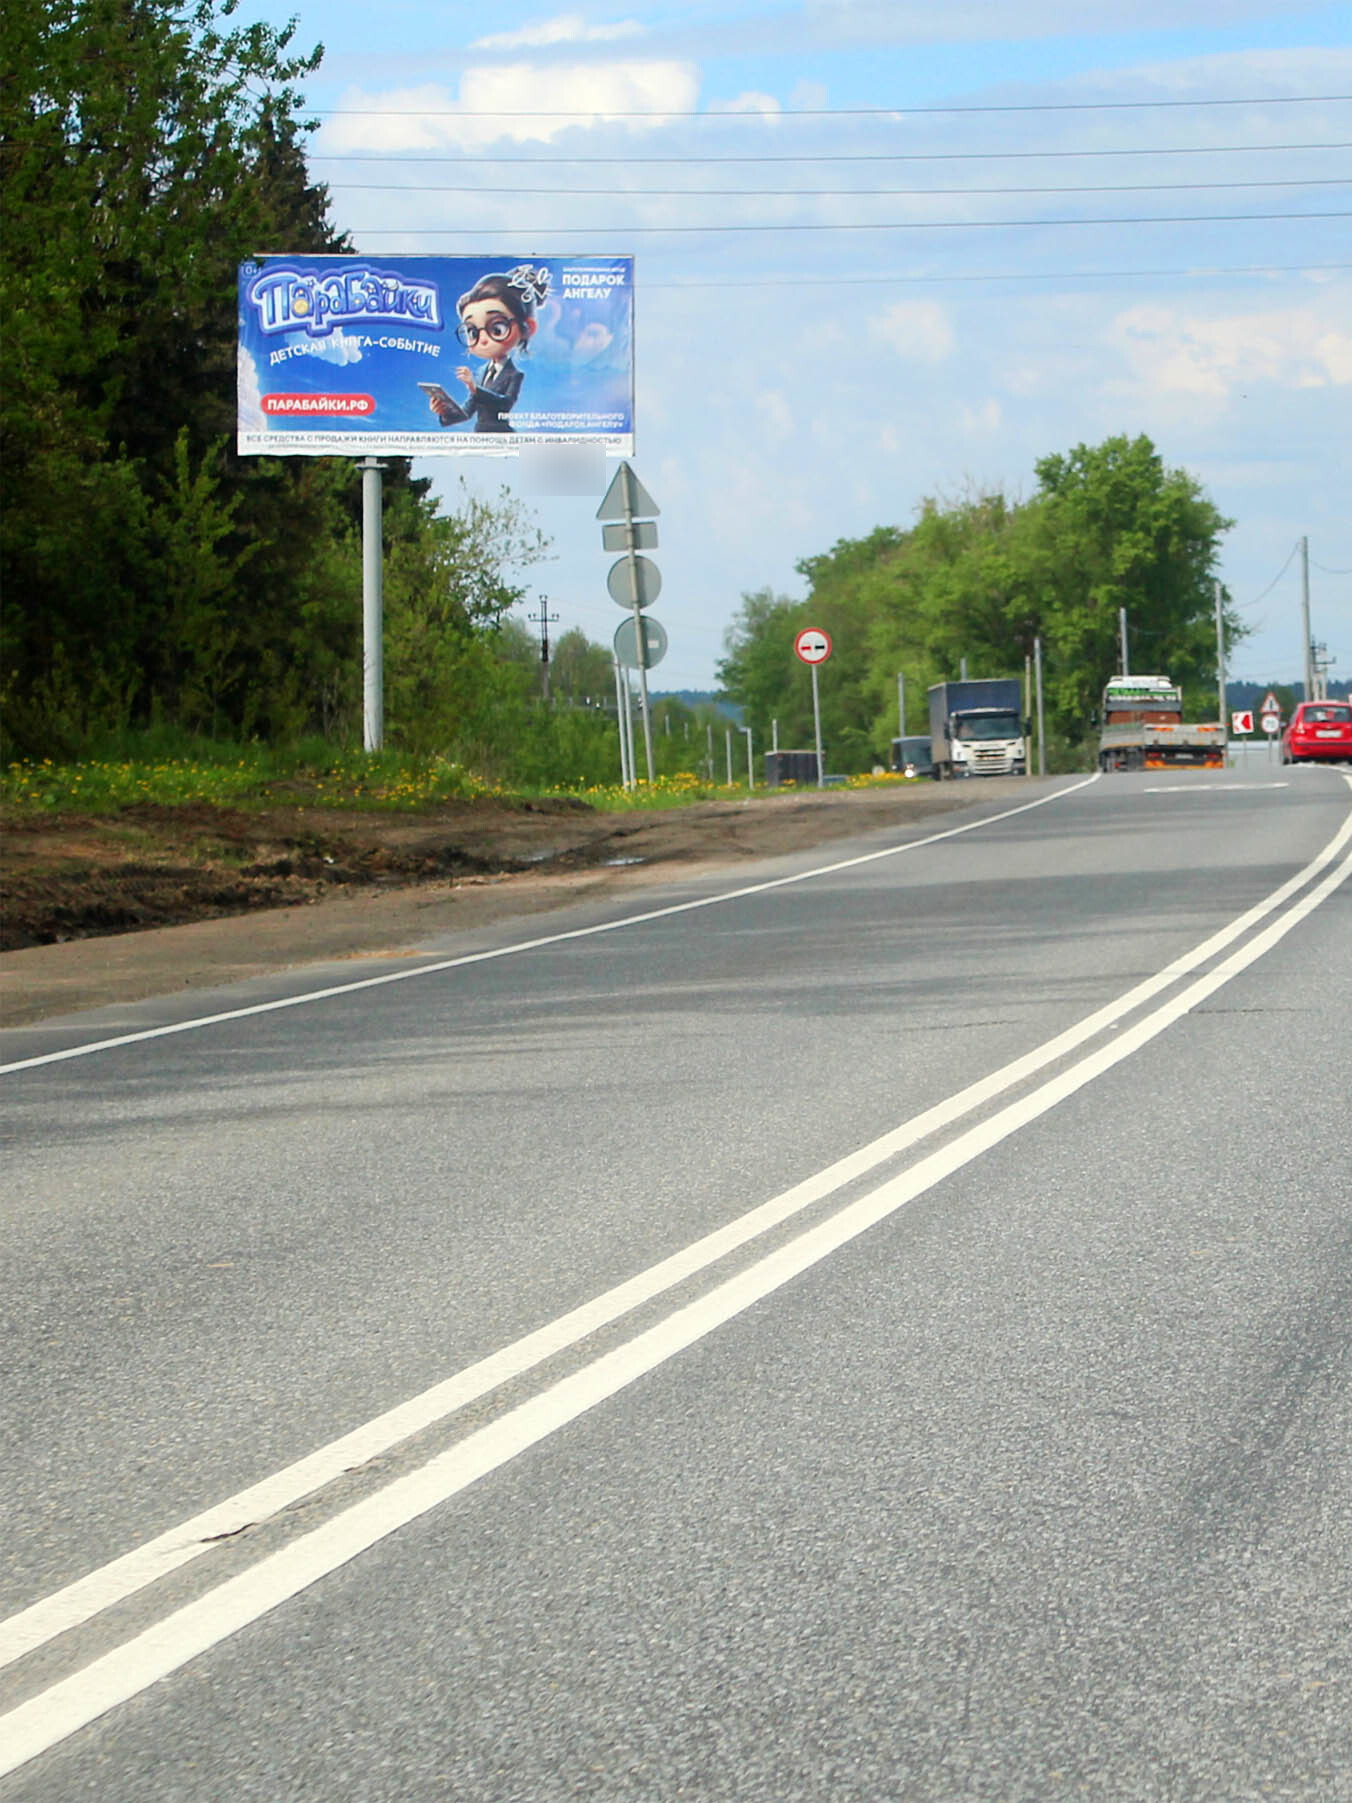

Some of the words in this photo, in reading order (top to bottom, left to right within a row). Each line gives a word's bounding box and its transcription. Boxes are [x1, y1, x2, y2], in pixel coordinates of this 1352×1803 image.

[562, 273, 625, 286] ПОДАРОК
[562, 287, 612, 299] АНГЕЛУ
[269, 339, 327, 366] ДЕТСКАЯ
[331, 336, 441, 358] КНИГА-СОБЫТИЕ
[267, 397, 369, 411] ПАРАБАЙКИ.РФ
[314, 435, 357, 443] ПРОДАЖИ
[358, 435, 386, 443] КНИГИ
[387, 435, 455, 443] НАПРАВЛЯЮТСЯ
[508, 436, 536, 444] ДЕТЯМ
[544, 436, 622, 444] ИНВАЛИДНОСТЬЮ
